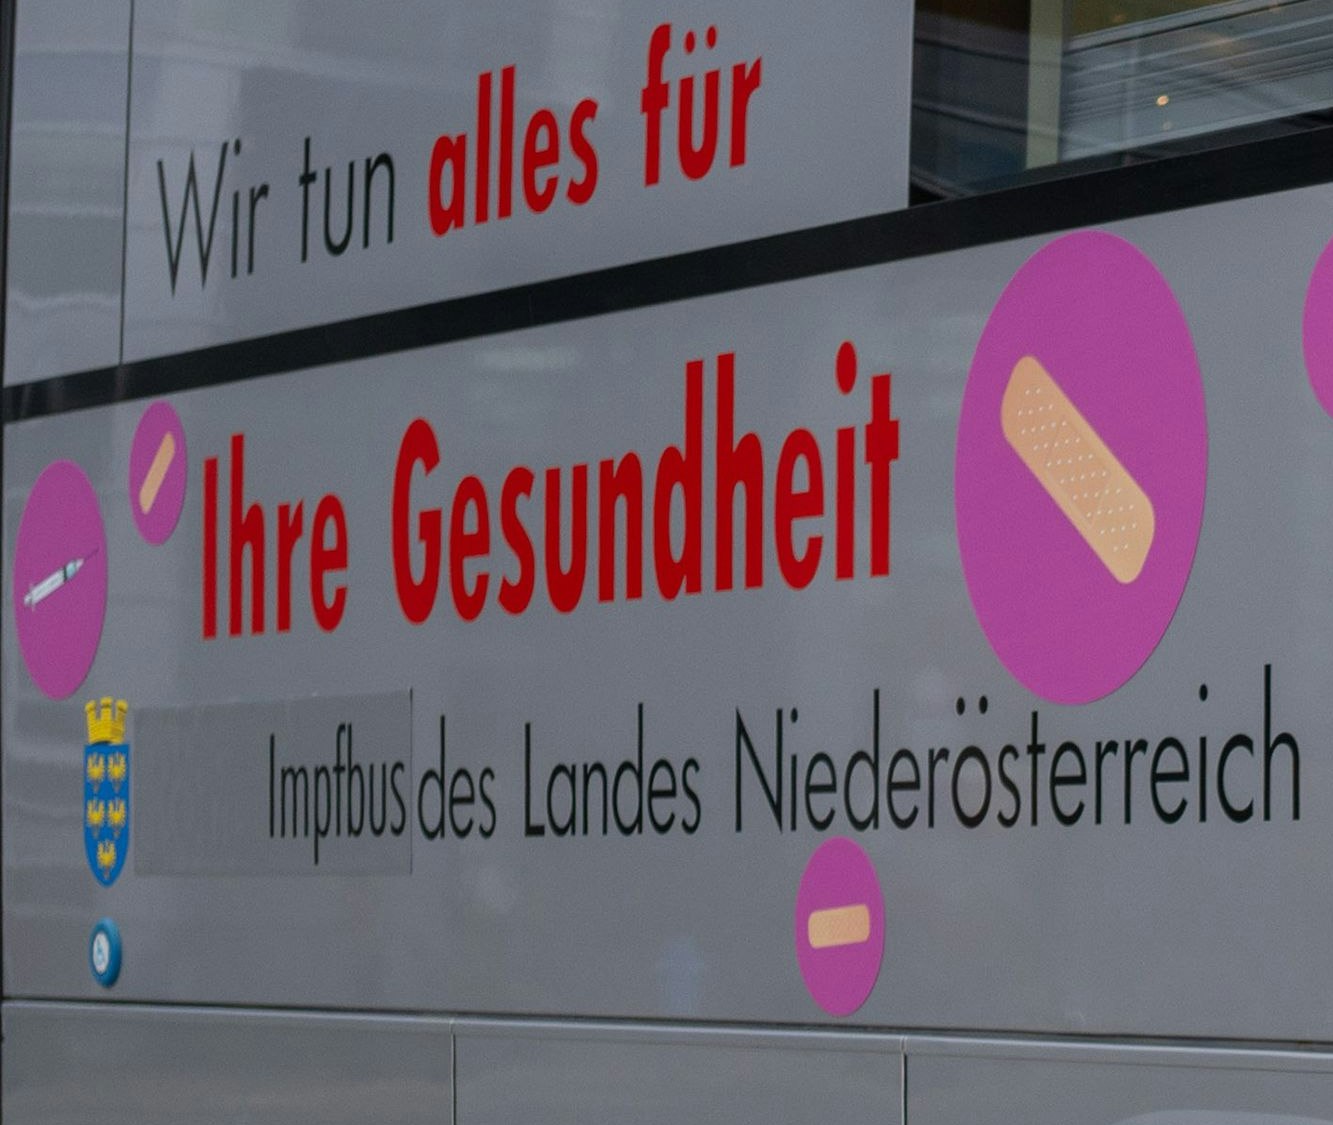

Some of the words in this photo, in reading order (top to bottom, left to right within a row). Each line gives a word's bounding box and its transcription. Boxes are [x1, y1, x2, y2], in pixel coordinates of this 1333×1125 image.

[157, 139, 269, 297] Wir
[298, 136, 396, 263] tun
[427, 64, 600, 238] alles
[641, 22, 764, 188] für
[202, 433, 349, 641] Ihre
[392, 340, 900, 624] Gesundheit
[268, 722, 407, 866] Impfbus
[417, 714, 497, 841] des
[523, 701, 702, 838] Landes
[734, 663, 1302, 835] Niederösterreich
